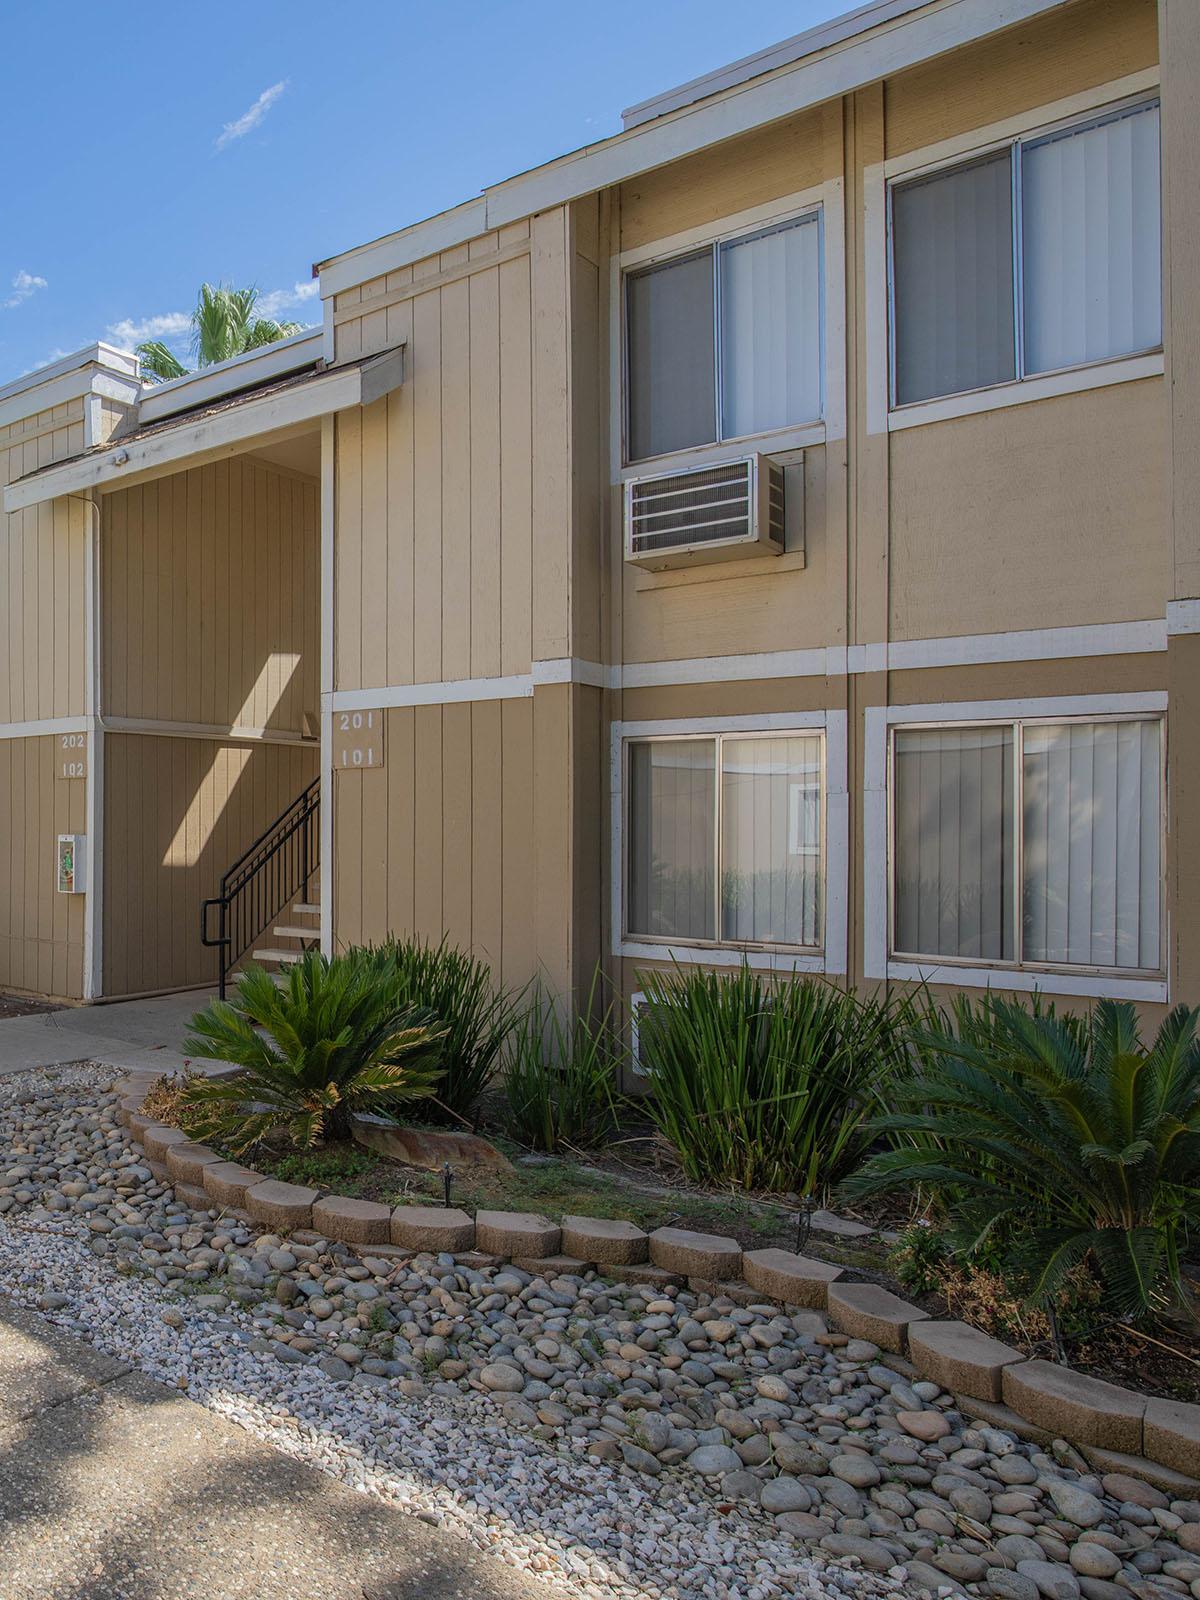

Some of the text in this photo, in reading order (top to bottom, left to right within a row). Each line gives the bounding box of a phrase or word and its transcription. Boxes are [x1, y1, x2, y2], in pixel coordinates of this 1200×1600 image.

[340, 711, 373, 730] 201
[62, 735, 84, 749] 202
[343, 748, 373, 767] 101
[63, 762, 84, 777] 102
